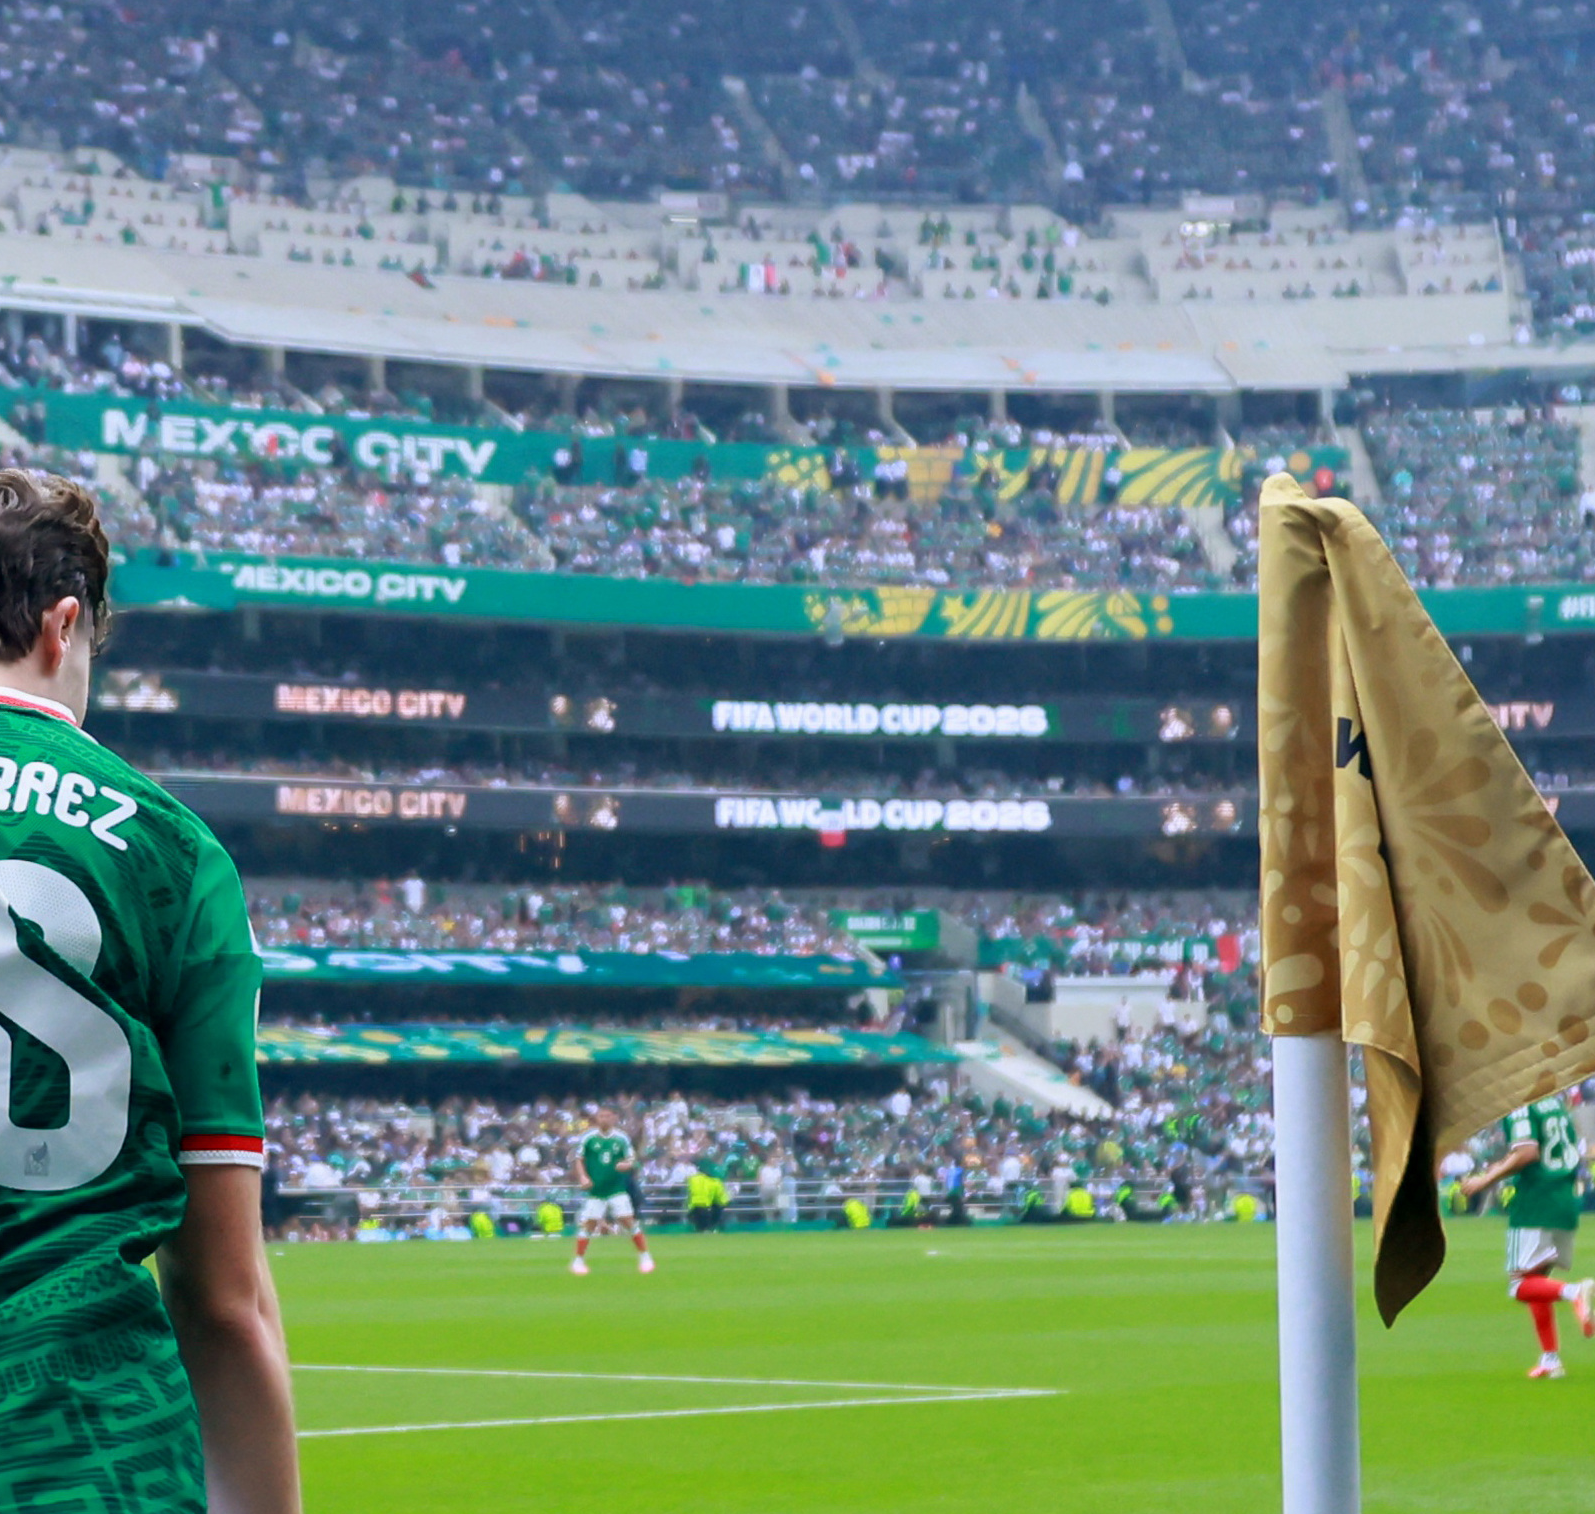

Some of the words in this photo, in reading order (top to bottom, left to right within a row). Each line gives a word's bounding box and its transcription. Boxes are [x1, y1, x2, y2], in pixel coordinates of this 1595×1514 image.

[355, 431, 497, 475] CITY
[375, 571, 467, 603] CITY
[276, 683, 392, 716] MEXICO
[396, 689, 467, 719] CITY
[711, 700, 776, 732] FIFA
[774, 701, 880, 734] WORLD
[880, 703, 942, 735] CUP
[940, 703, 1049, 736] 2026
[1488, 701, 1555, 731] ITY
[276, 786, 394, 817] MEXICO
[398, 789, 467, 819] CITY
[714, 797, 779, 829] FIFA
[882, 798, 944, 831] CUP
[942, 799, 1052, 832] 2026
